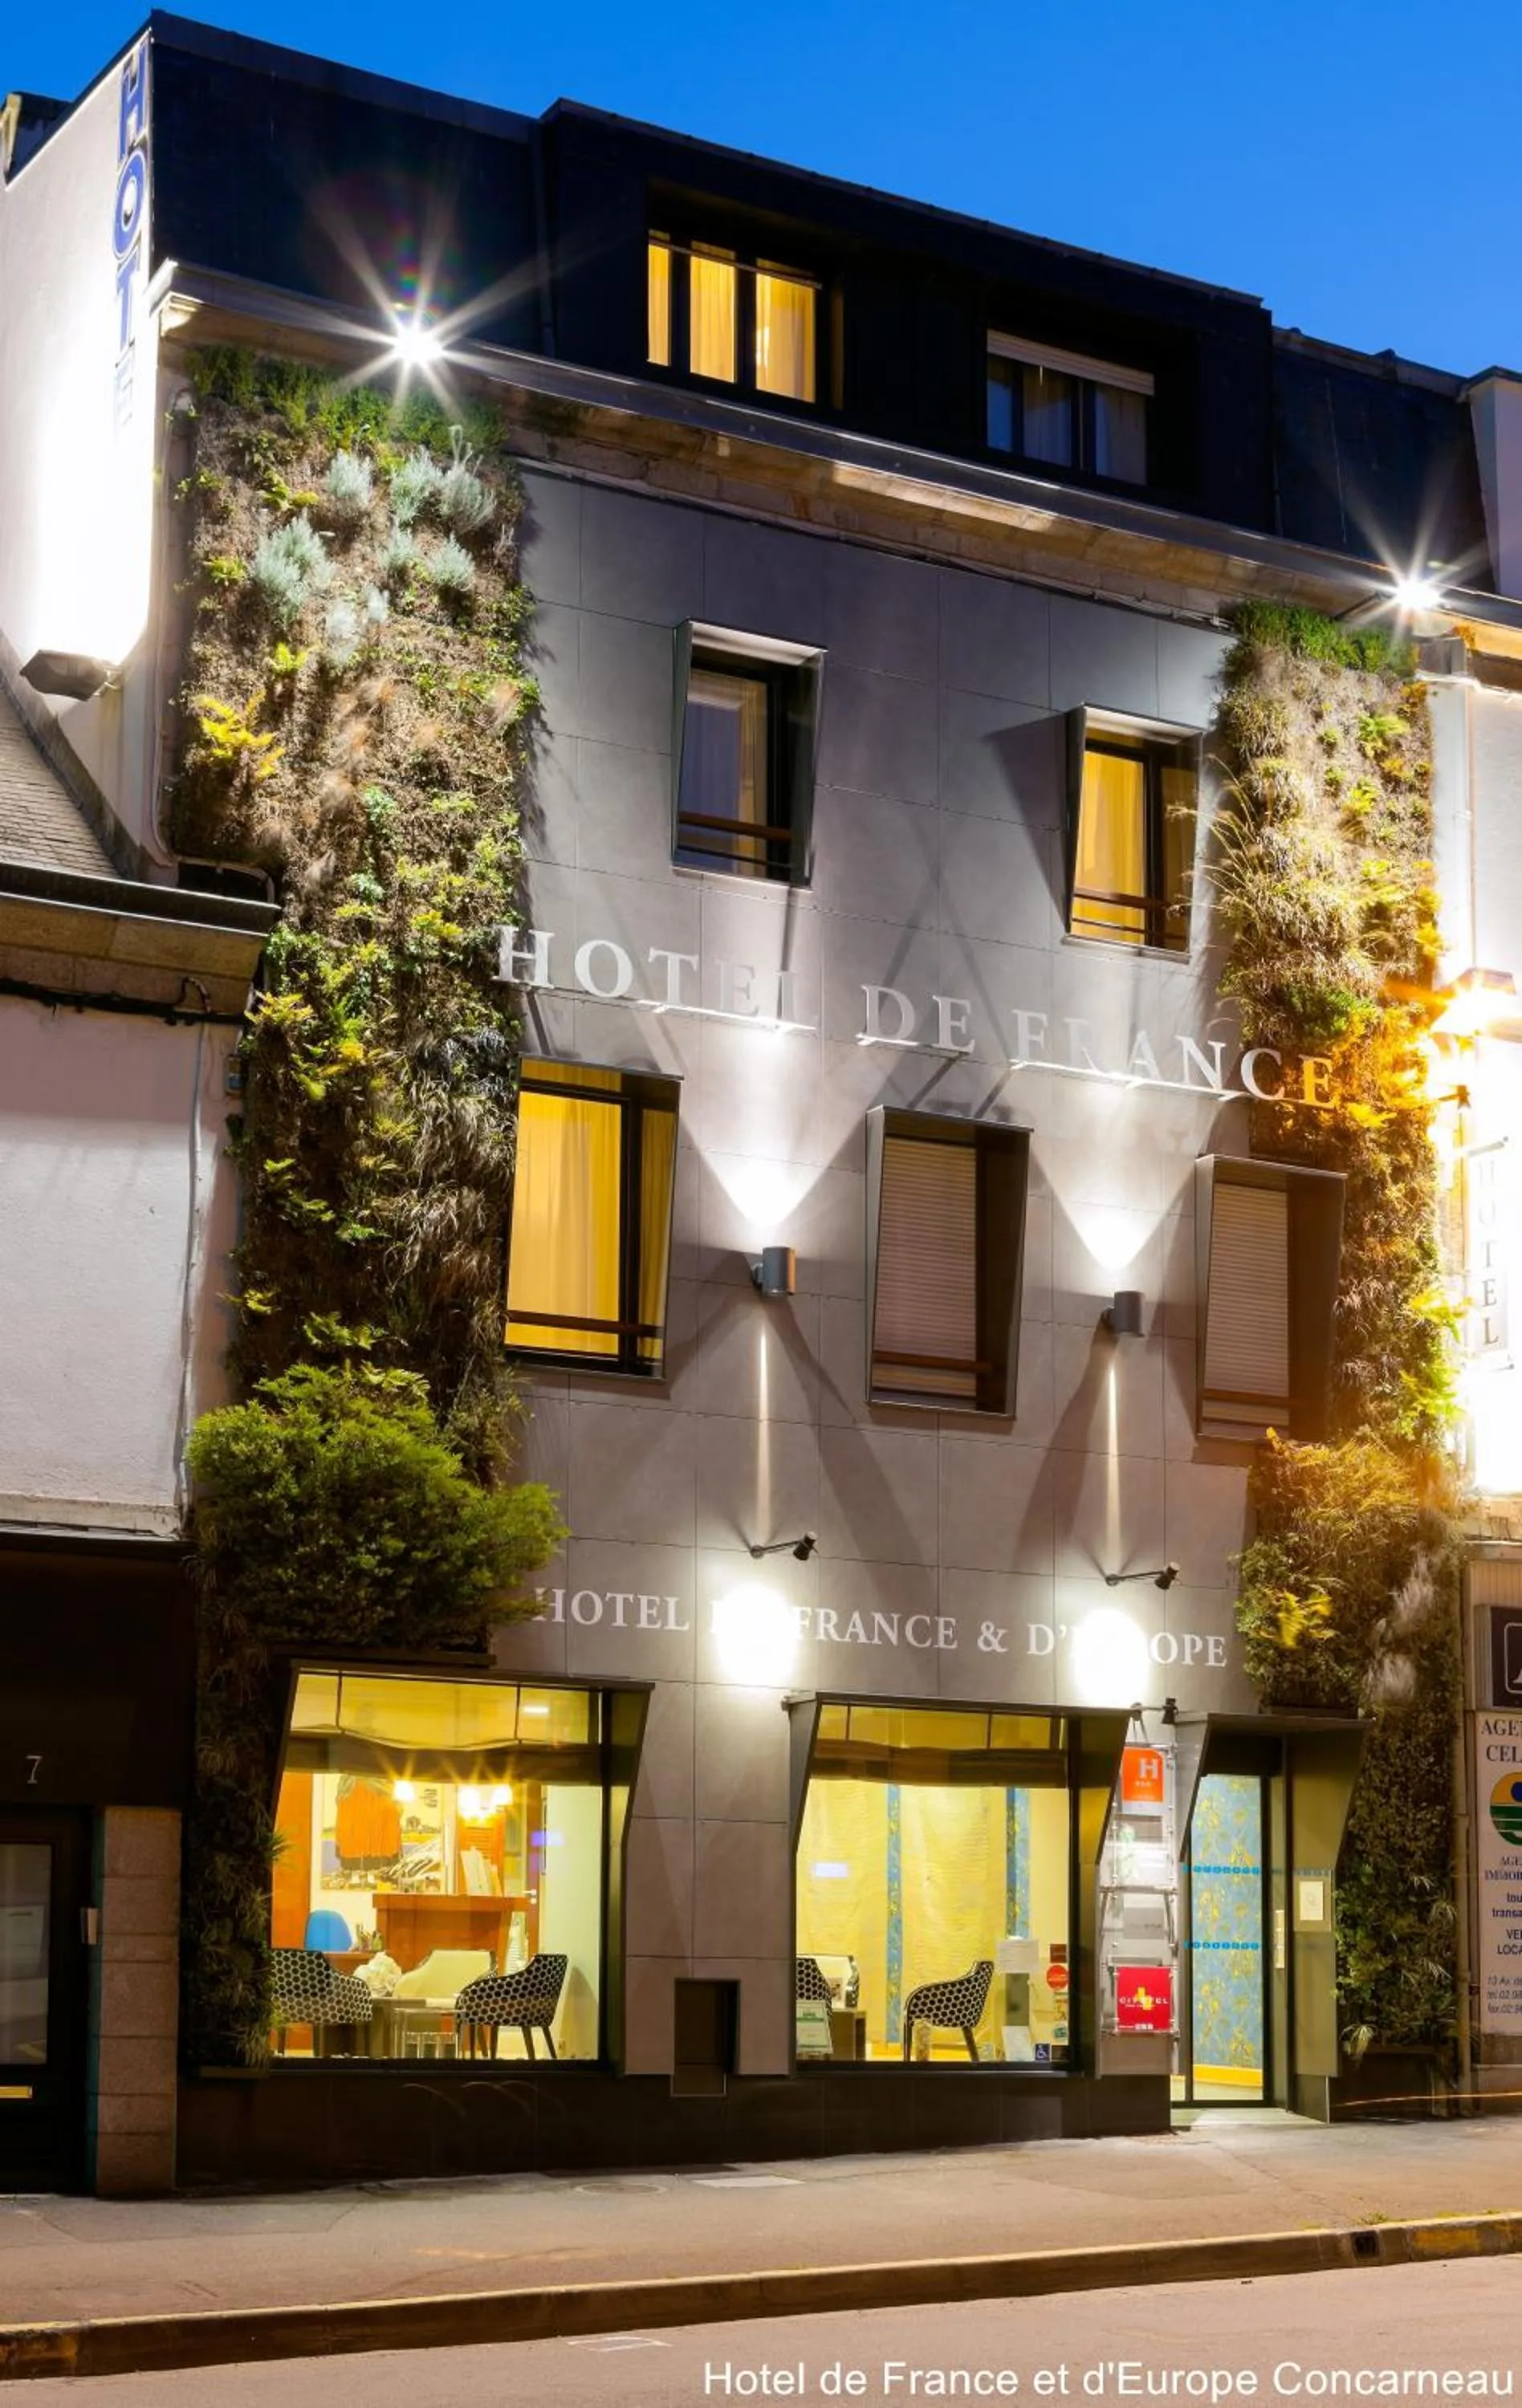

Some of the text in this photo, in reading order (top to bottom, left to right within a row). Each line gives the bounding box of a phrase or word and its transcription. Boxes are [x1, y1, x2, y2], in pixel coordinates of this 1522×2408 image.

[491, 925, 1336, 1109] HOTEL DE FRANCE
[533, 1588, 690, 1630] HOTEL
[791, 1605, 958, 1649] FRANCE
[977, 1621, 1008, 1653] &
[1481, 1719, 1522, 1736] AGE
[26, 1755, 42, 1784] 7
[1140, 1757, 1158, 1780] H
[1506, 1929, 1522, 1940] VE
